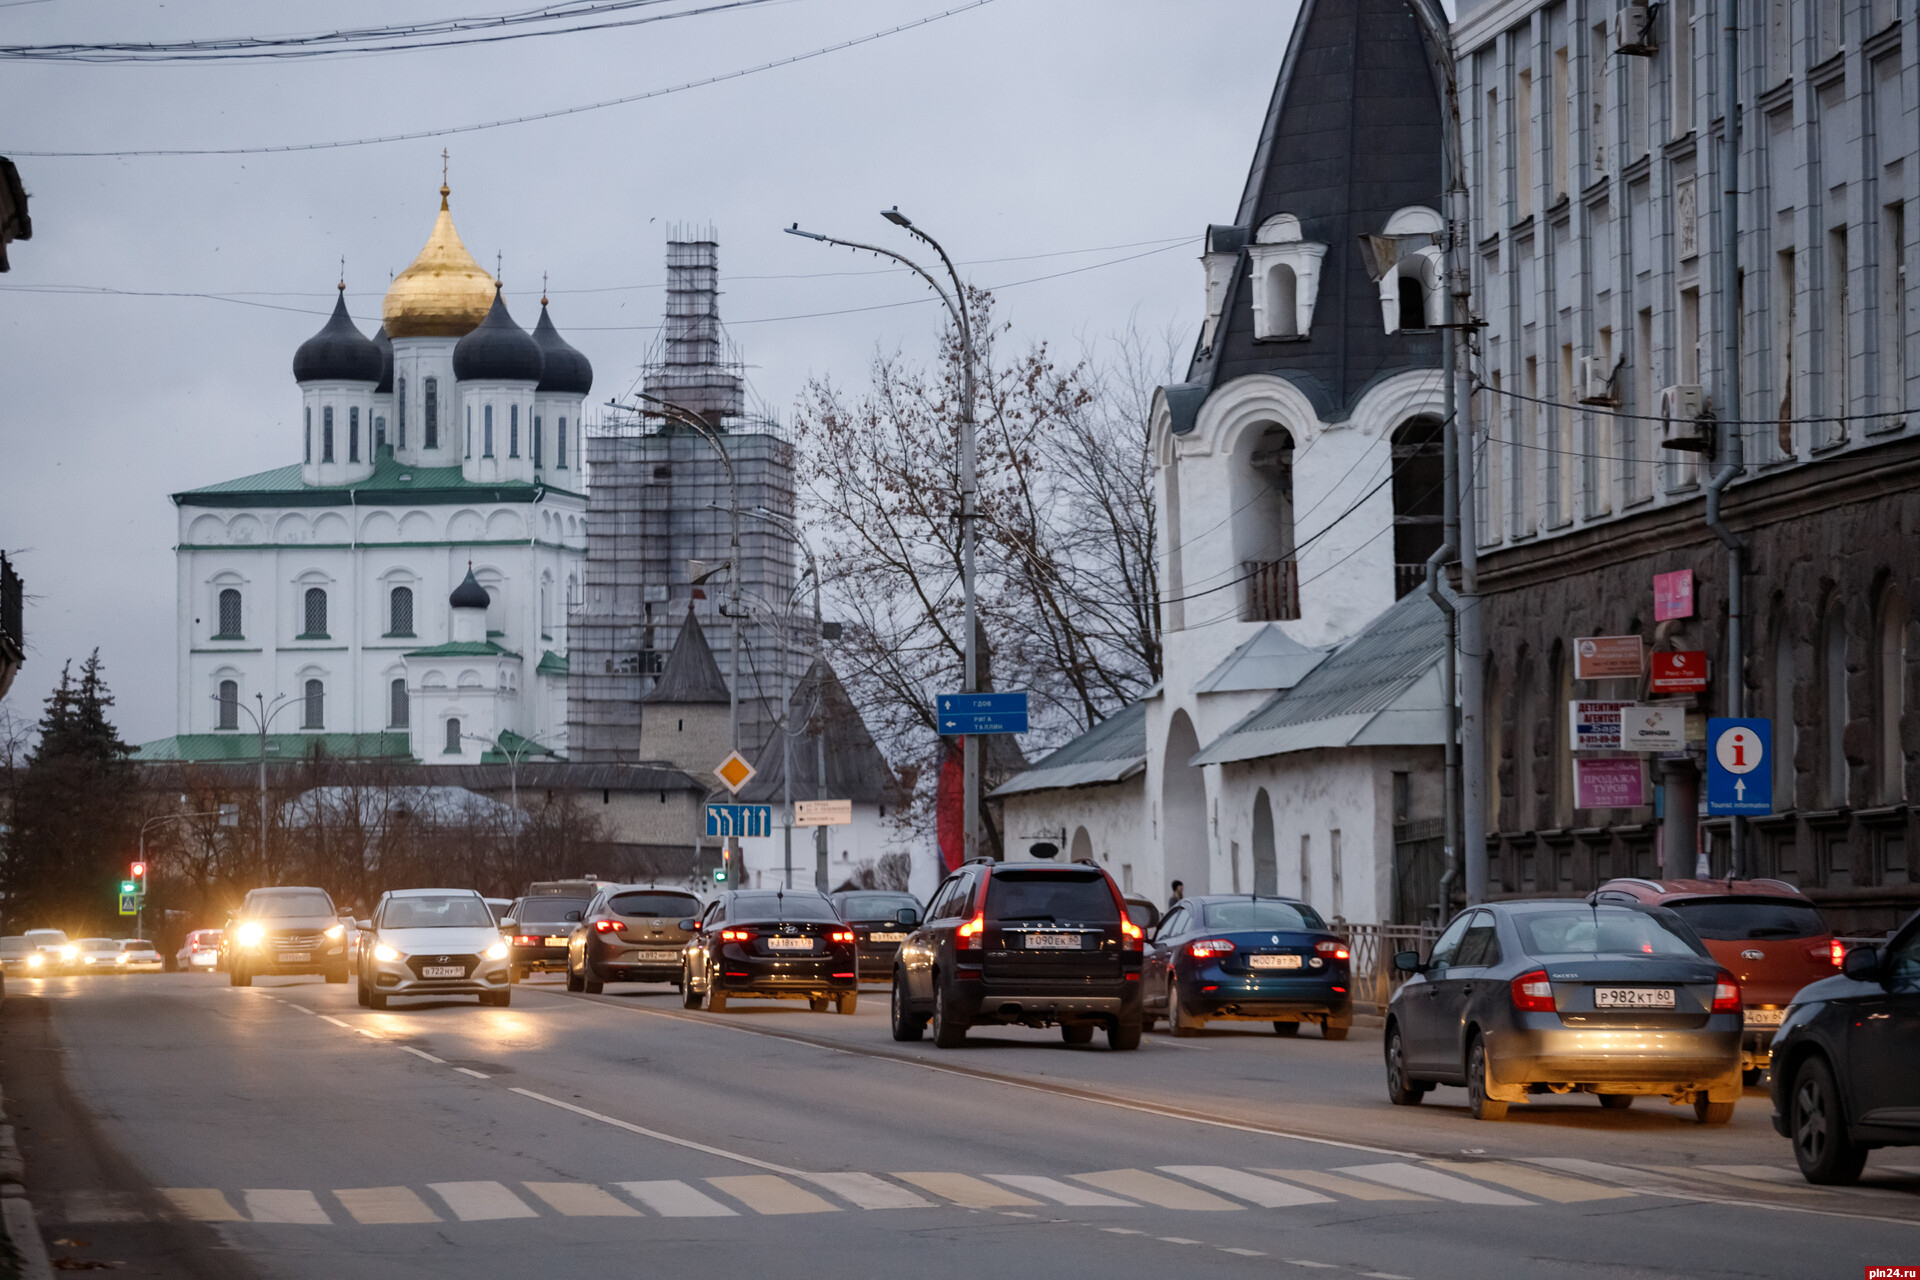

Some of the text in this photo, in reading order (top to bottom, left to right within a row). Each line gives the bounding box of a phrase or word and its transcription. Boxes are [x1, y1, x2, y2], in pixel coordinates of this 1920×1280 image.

[1583, 774, 1637, 784] ПРОДАЖА
[1592, 784, 1628, 793] ТУРОВ
[1601, 990, 1653, 1003] Р982КТ
